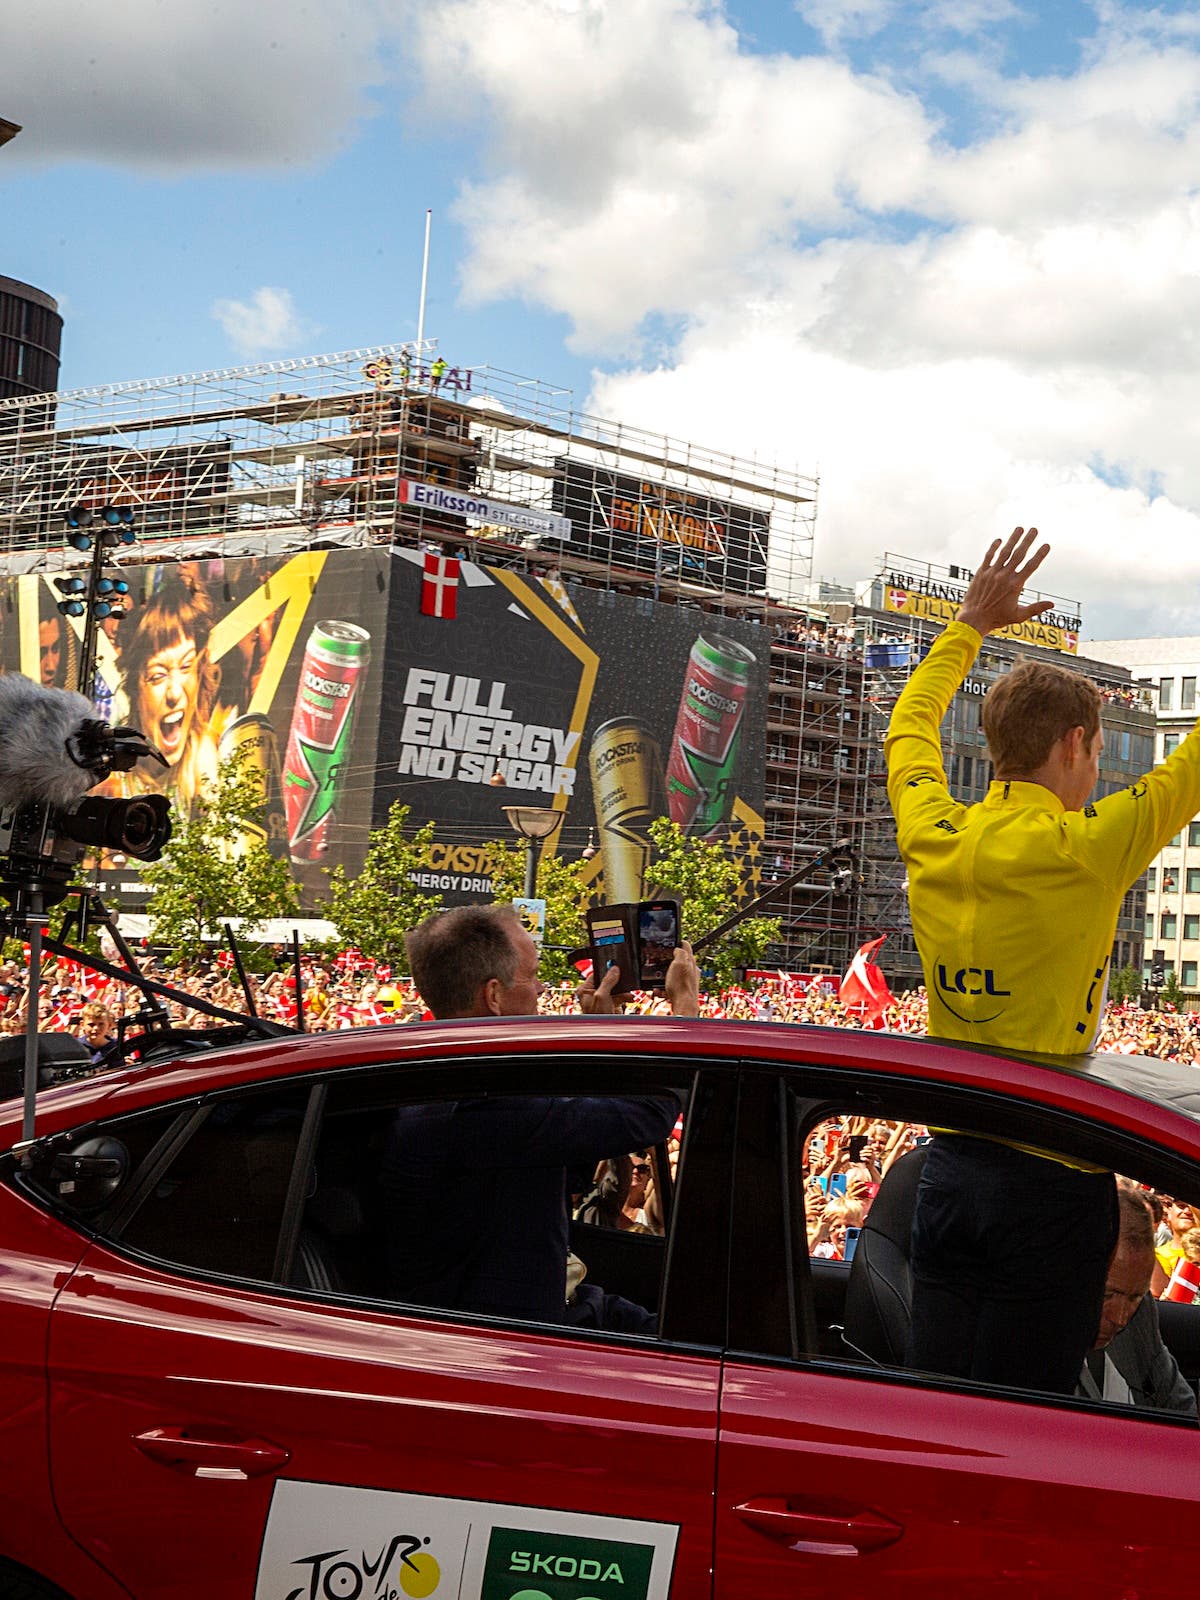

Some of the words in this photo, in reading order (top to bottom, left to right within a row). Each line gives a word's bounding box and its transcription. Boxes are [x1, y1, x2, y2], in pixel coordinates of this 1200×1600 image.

[414, 485, 488, 517] Eriksson
[888, 572, 914, 591] ARP
[919, 580, 967, 604] HANSE
[1040, 611, 1083, 633] GROUP
[911, 595, 960, 622] TILLY
[1002, 622, 1063, 646] JONAS!
[403, 668, 513, 720] FULL
[400, 706, 582, 766] ENERGY
[397, 744, 457, 779] NO
[457, 752, 577, 796] SUGAR
[461, 877, 503, 894] DRIN
[938, 964, 1011, 996] LCL
[289, 1535, 422, 1600] TOUR
